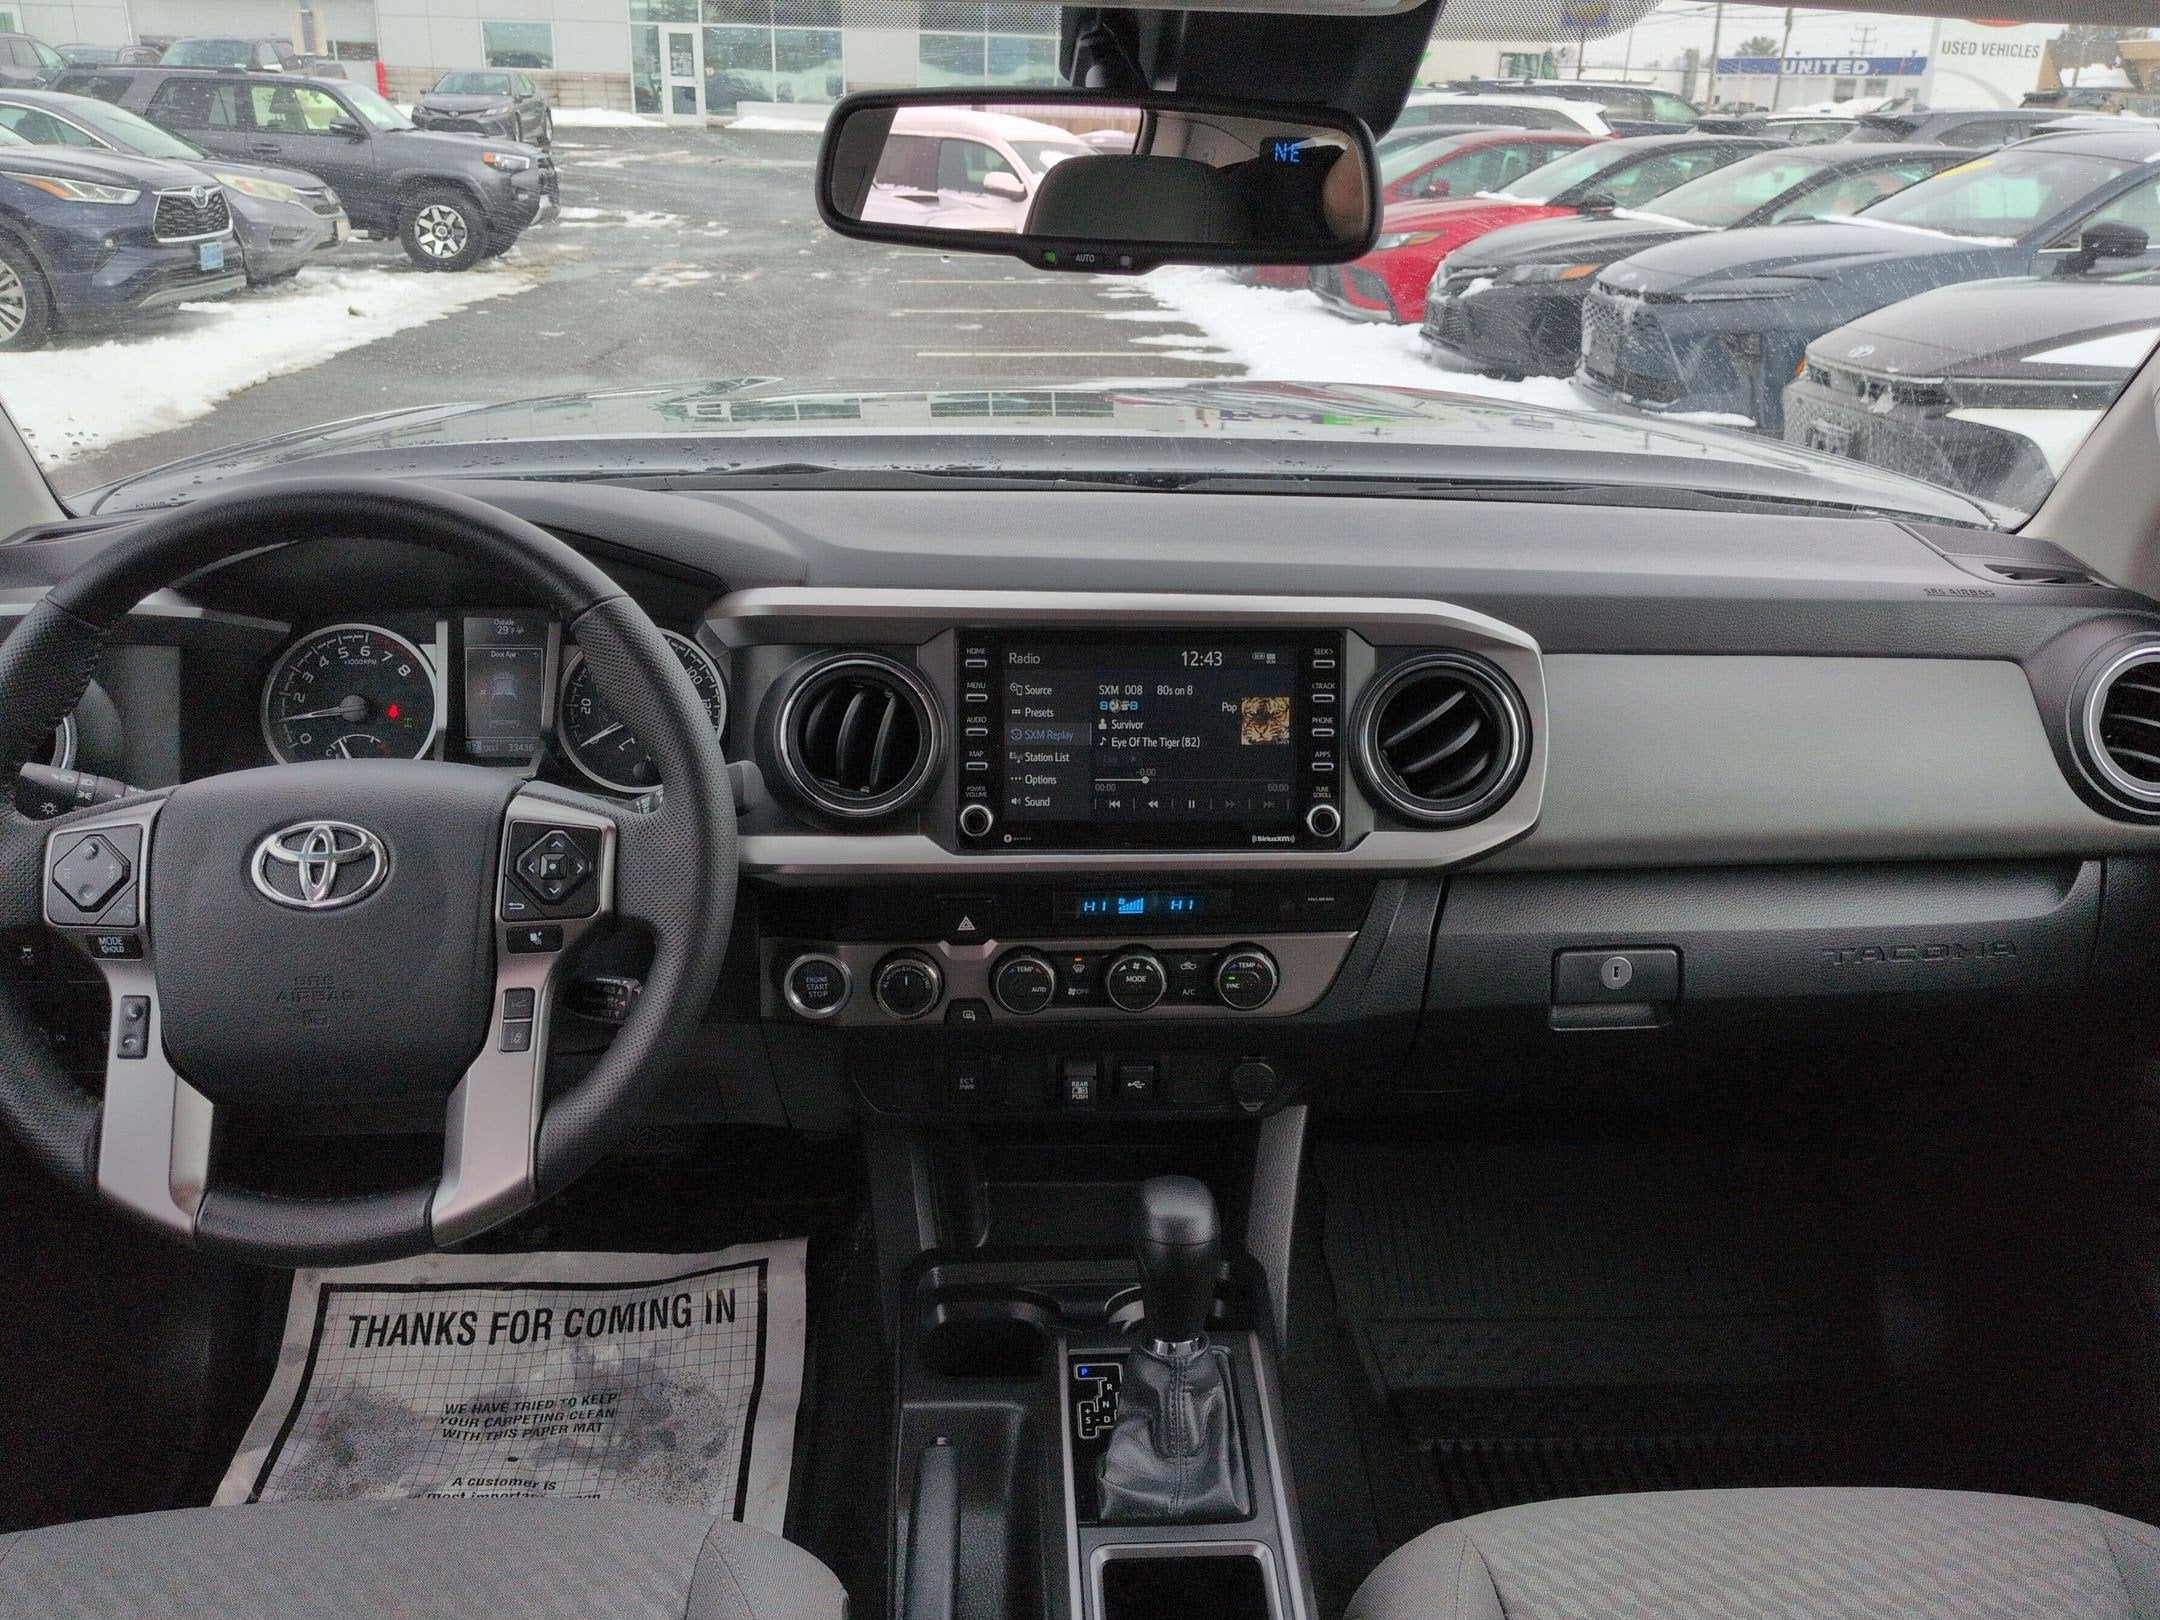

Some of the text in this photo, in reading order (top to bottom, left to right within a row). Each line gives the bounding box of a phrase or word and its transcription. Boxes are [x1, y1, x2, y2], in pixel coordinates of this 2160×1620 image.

[1941, 40, 2041, 59] USED VEHICLES
[1781, 59, 1871, 76] UNITED
[1274, 142, 1300, 162] NE
[1075, 254, 1095, 263] AUTO
[1949, 588, 1996, 598] AIRBAG
[338, 646, 349, 659] 5
[360, 645, 371, 657] 6
[381, 650, 394, 663] 7
[319, 655, 330, 668] 4
[1008, 652, 1041, 664] Radio
[1181, 650, 1223, 667] 12:43
[398, 664, 411, 677] 8
[302, 671, 315, 684] 3
[1024, 684, 1053, 696] Source
[1098, 684, 1194, 696] SXM 008 80s on 8
[293, 691, 306, 704] 2
[1024, 707, 1055, 718] Presets
[1221, 701, 1238, 714] Pop
[966, 716, 987, 724] AUDIO
[1111, 719, 1144, 730] Survivor
[300, 732, 312, 745] 0
[1024, 729, 1074, 743] SXM Replay
[1111, 735, 1201, 750] Eye Of The Tiger (82)
[968, 750, 984, 758] MAP
[1024, 751, 1071, 762] Station List
[1024, 774, 1057, 786] Options
[1094, 783, 1117, 792] 00:00
[1024, 796, 1051, 807] Sound
[98, 936, 124, 946] MODE
[1822, 942, 2016, 965] TACOMA
[1125, 975, 1148, 983] MODE
[808, 990, 828, 998] STOP
[1182, 988, 1196, 996] A/C
[348, 1288, 736, 1348] THANKS FOR COMING IN
[1081, 1368, 1088, 1376] P
[1106, 1383, 1113, 1391] R
[445, 1391, 619, 1415] WE HAVE TRIED TO KEEP
[1102, 1400, 1110, 1409] N
[440, 1407, 616, 1428] YOUR CARPETING CLEAN
[1085, 1415, 1111, 1425] S D
[441, 1422, 606, 1441] WITH THIS PAPER MAT
[451, 1477, 557, 1491] A customer is
